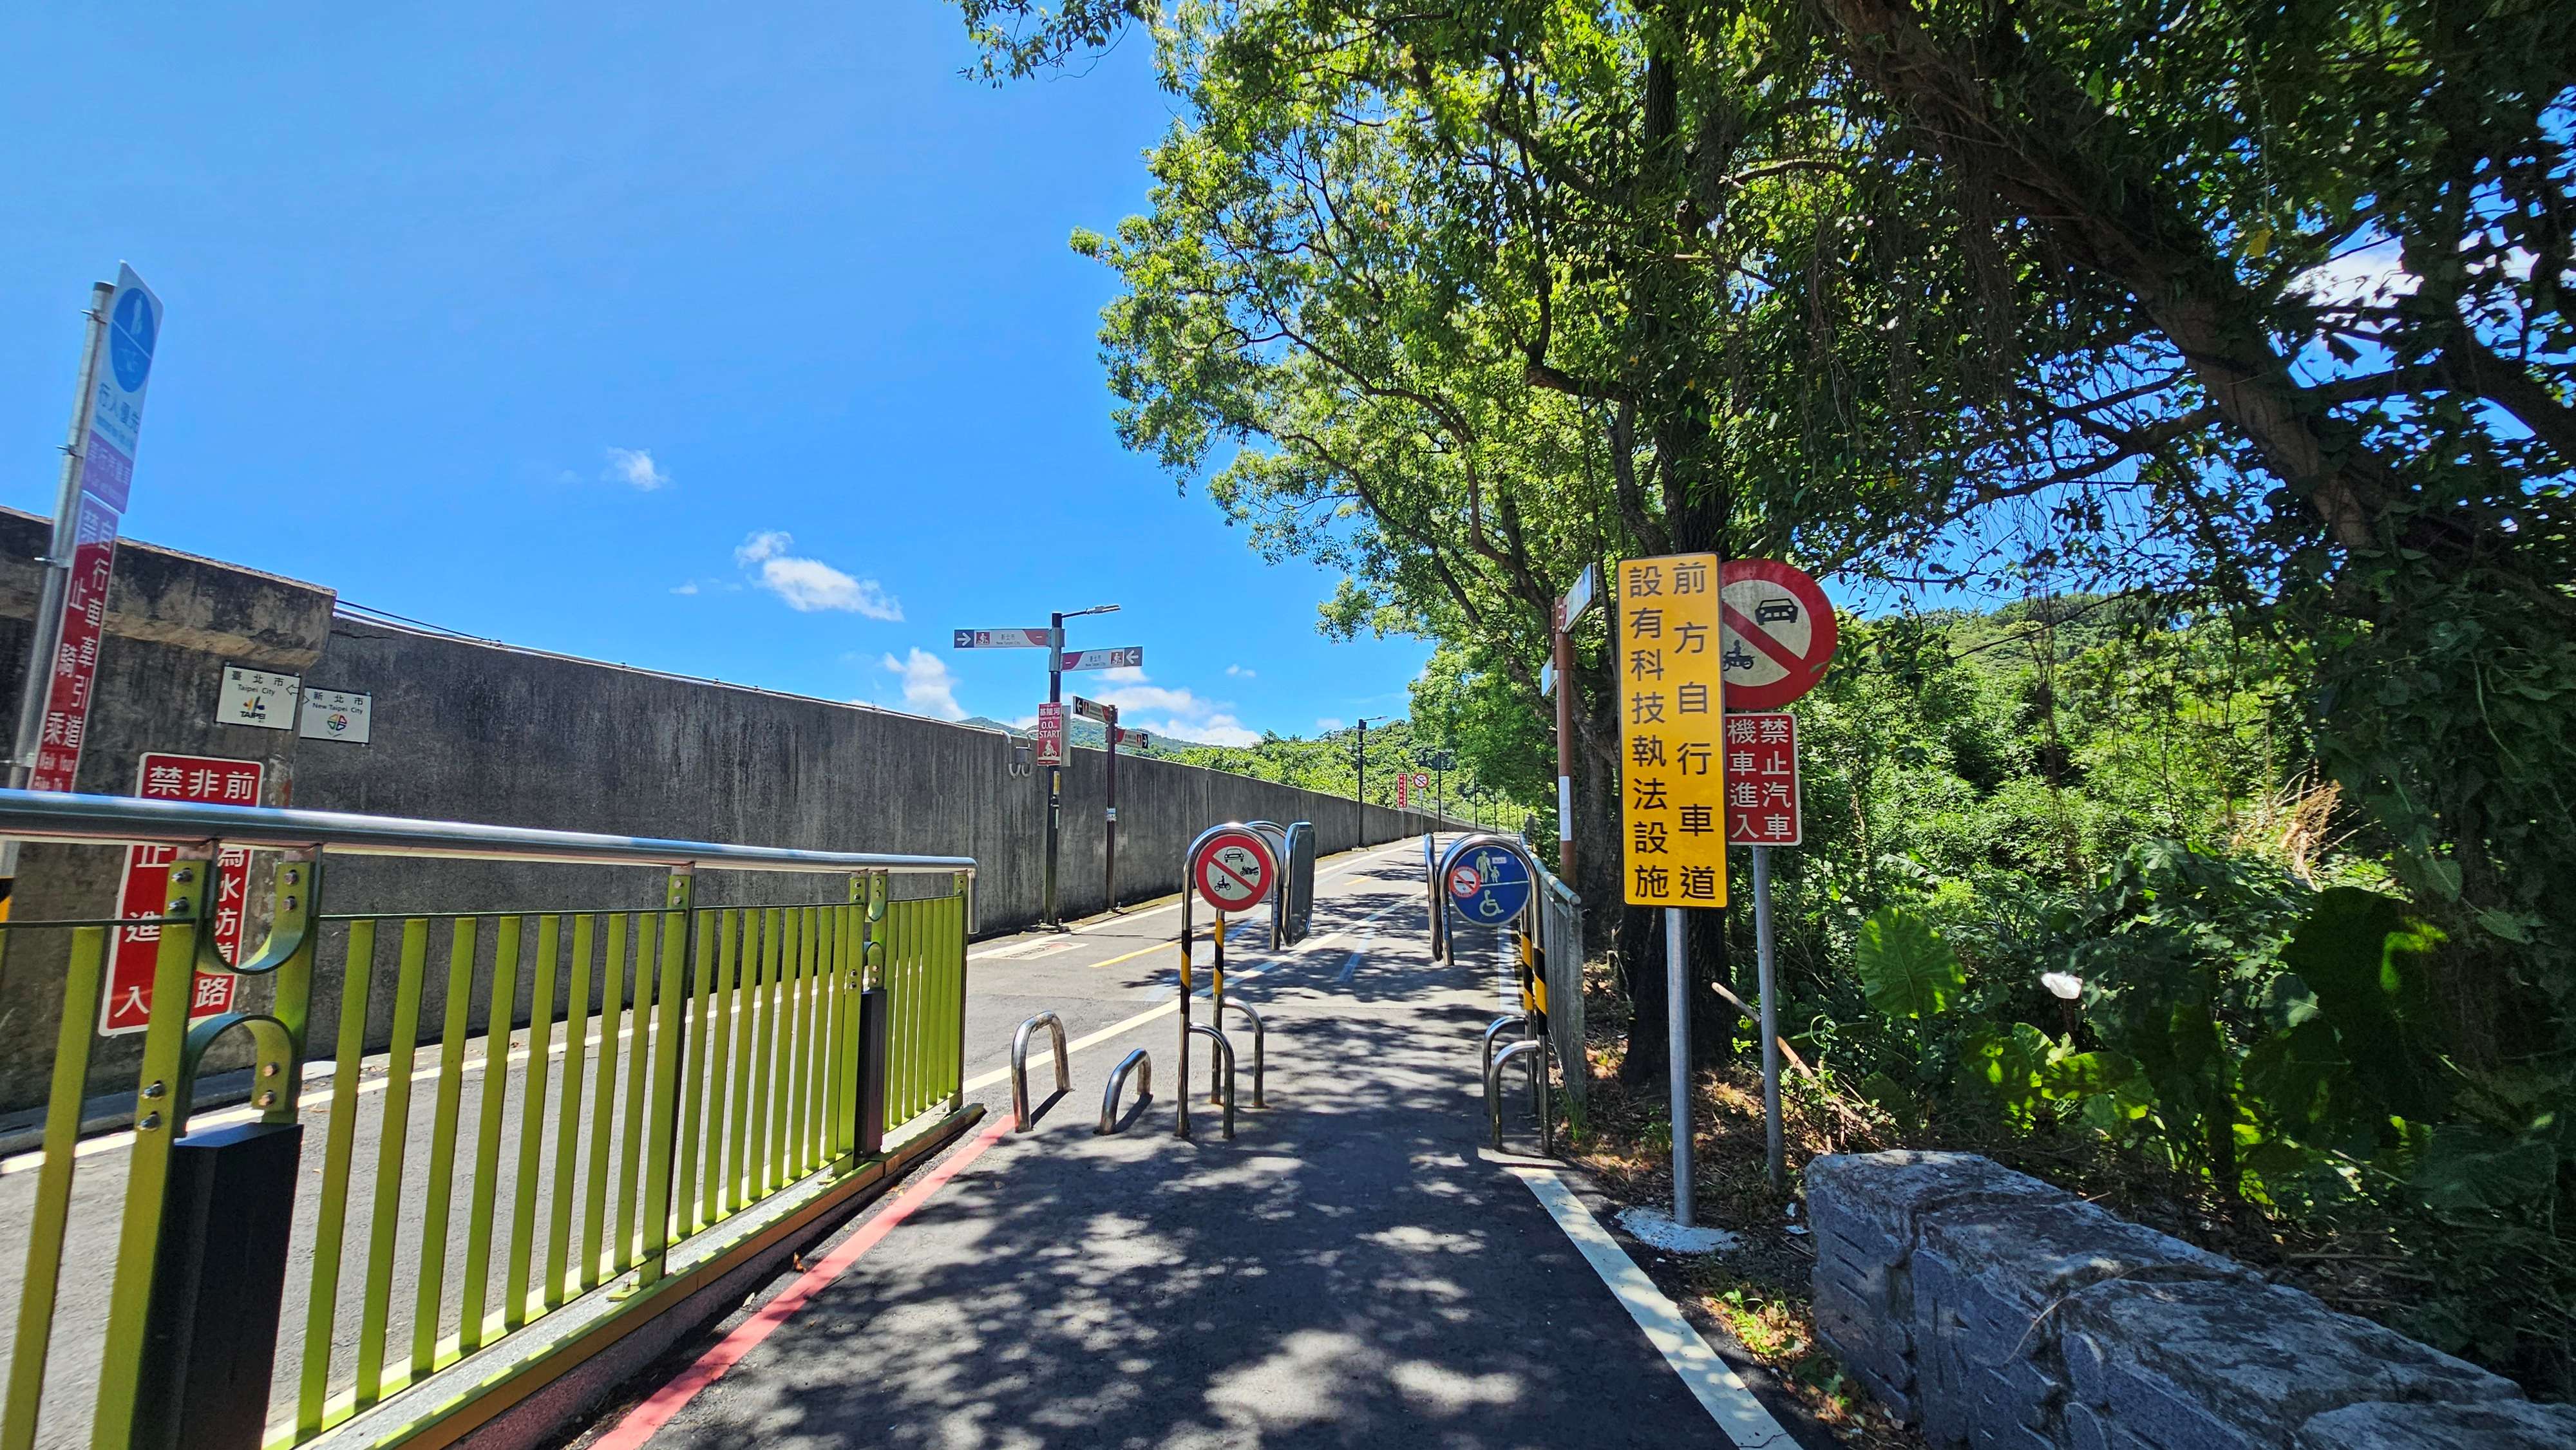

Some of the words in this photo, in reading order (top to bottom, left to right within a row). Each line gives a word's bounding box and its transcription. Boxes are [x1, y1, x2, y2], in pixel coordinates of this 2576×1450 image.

[43, 509, 99, 746] 禁止騎乘
[231, 670, 285, 687] 臺北市
[238, 684, 258, 693] Taipei
[262, 687, 275, 697] City
[314, 692, 364, 706] 新北市
[240, 711, 267, 720] TAIPEI
[350, 707, 364, 715] City
[1041, 720, 1053, 729] 0.0
[1629, 566, 1669, 899] 設有科技執法設施
[1672, 561, 1716, 900] 前方自行車道
[1727, 719, 1759, 839] 機車進入
[1760, 718, 1792, 840] 禁止汽車
